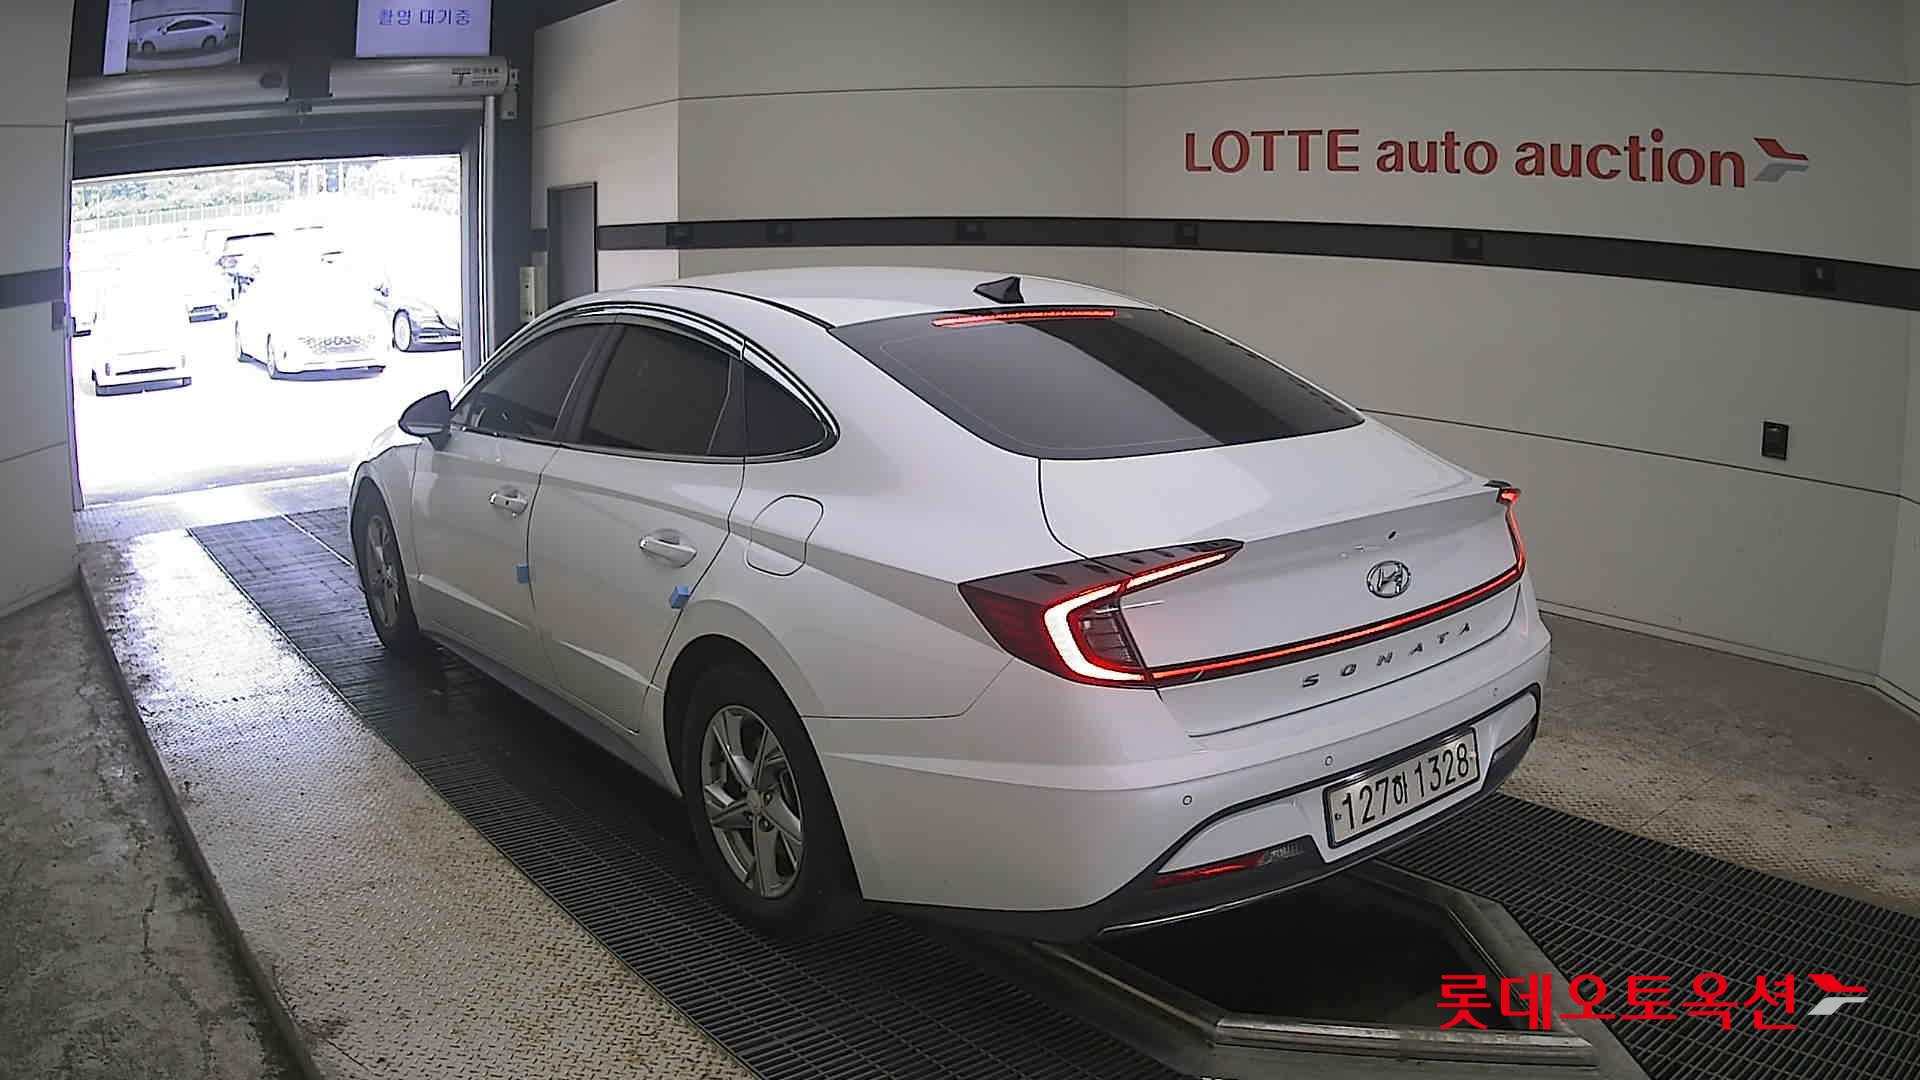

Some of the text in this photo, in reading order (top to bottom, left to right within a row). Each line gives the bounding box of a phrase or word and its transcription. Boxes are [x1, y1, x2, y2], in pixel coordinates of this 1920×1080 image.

[420, 8, 470, 26] 대기중
[1185, 128, 1745, 187] LOTTE auto auction
[1302, 622, 1471, 688] SONATA
[1342, 742, 1469, 830] 127하 1328
